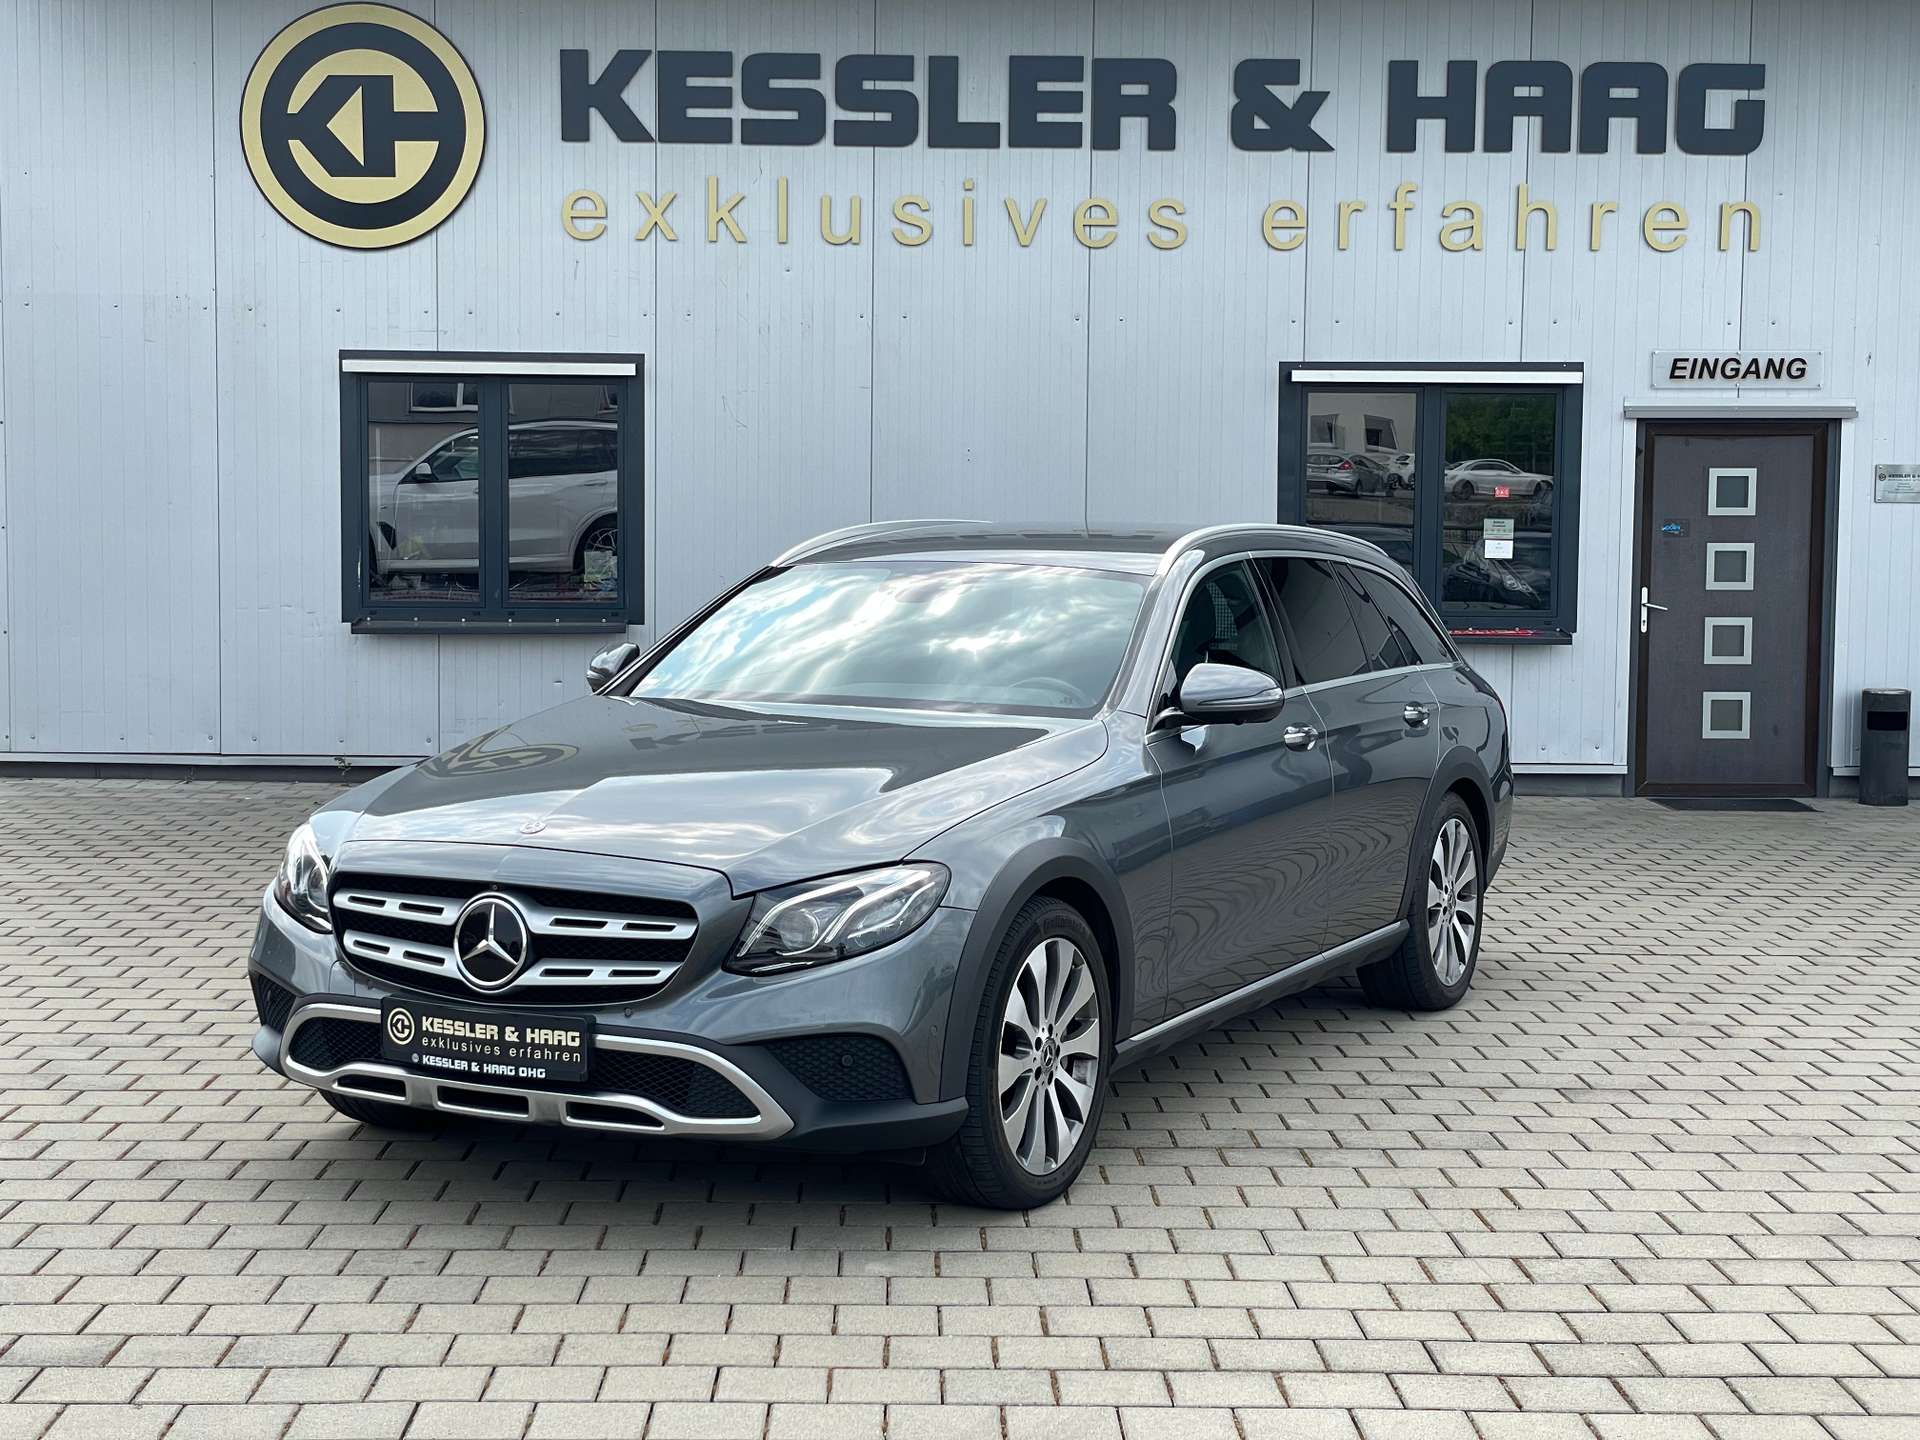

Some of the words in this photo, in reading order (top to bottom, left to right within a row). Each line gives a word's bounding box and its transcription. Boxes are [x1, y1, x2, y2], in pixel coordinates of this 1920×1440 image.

[559, 48, 1178, 154] KESSLER
[1230, 58, 1335, 154] &
[1386, 59, 1767, 156] HAAG
[562, 176, 1188, 251] exklusives
[1262, 183, 1763, 252] erfahren
[1668, 357, 1809, 381] EINGANG
[422, 1016, 499, 1040] KESSLER
[505, 1026, 520, 1042] &
[526, 1027, 580, 1047] HAAG
[422, 1037, 501, 1056] exklusives
[509, 1046, 581, 1063] erfahren
[422, 1054, 468, 1071] KESSLER
[471, 1061, 480, 1072] &
[483, 1063, 516, 1076] HAAG
[518, 1066, 546, 1078] OHG
